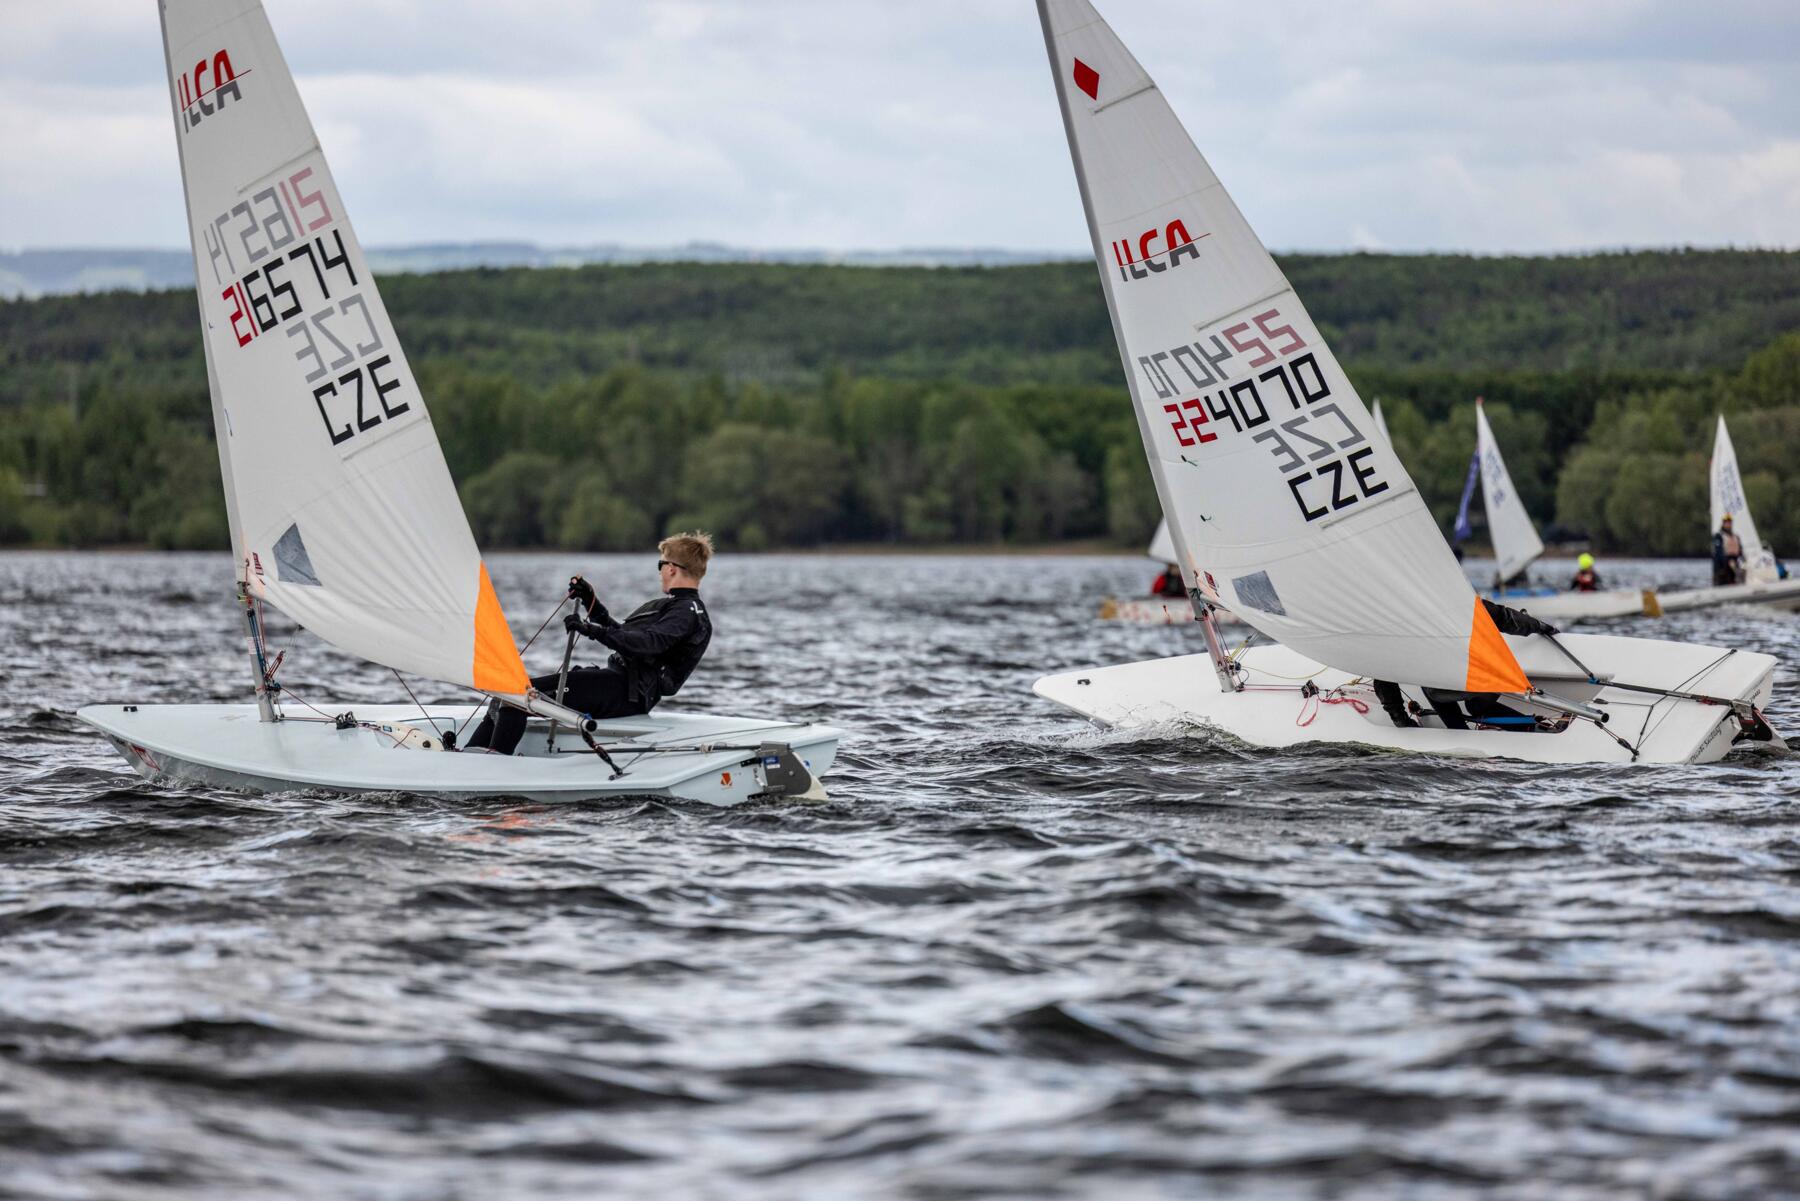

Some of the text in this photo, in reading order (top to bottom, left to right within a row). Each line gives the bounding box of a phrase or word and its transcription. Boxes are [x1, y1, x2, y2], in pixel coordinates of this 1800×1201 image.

[178, 49, 243, 134] ILCA
[222, 229, 358, 348] 216574
[1112, 219, 1201, 282] ILCA
[313, 355, 410, 446] CZE
[1163, 352, 1331, 447] 224070
[1287, 446, 1389, 522] CZE
